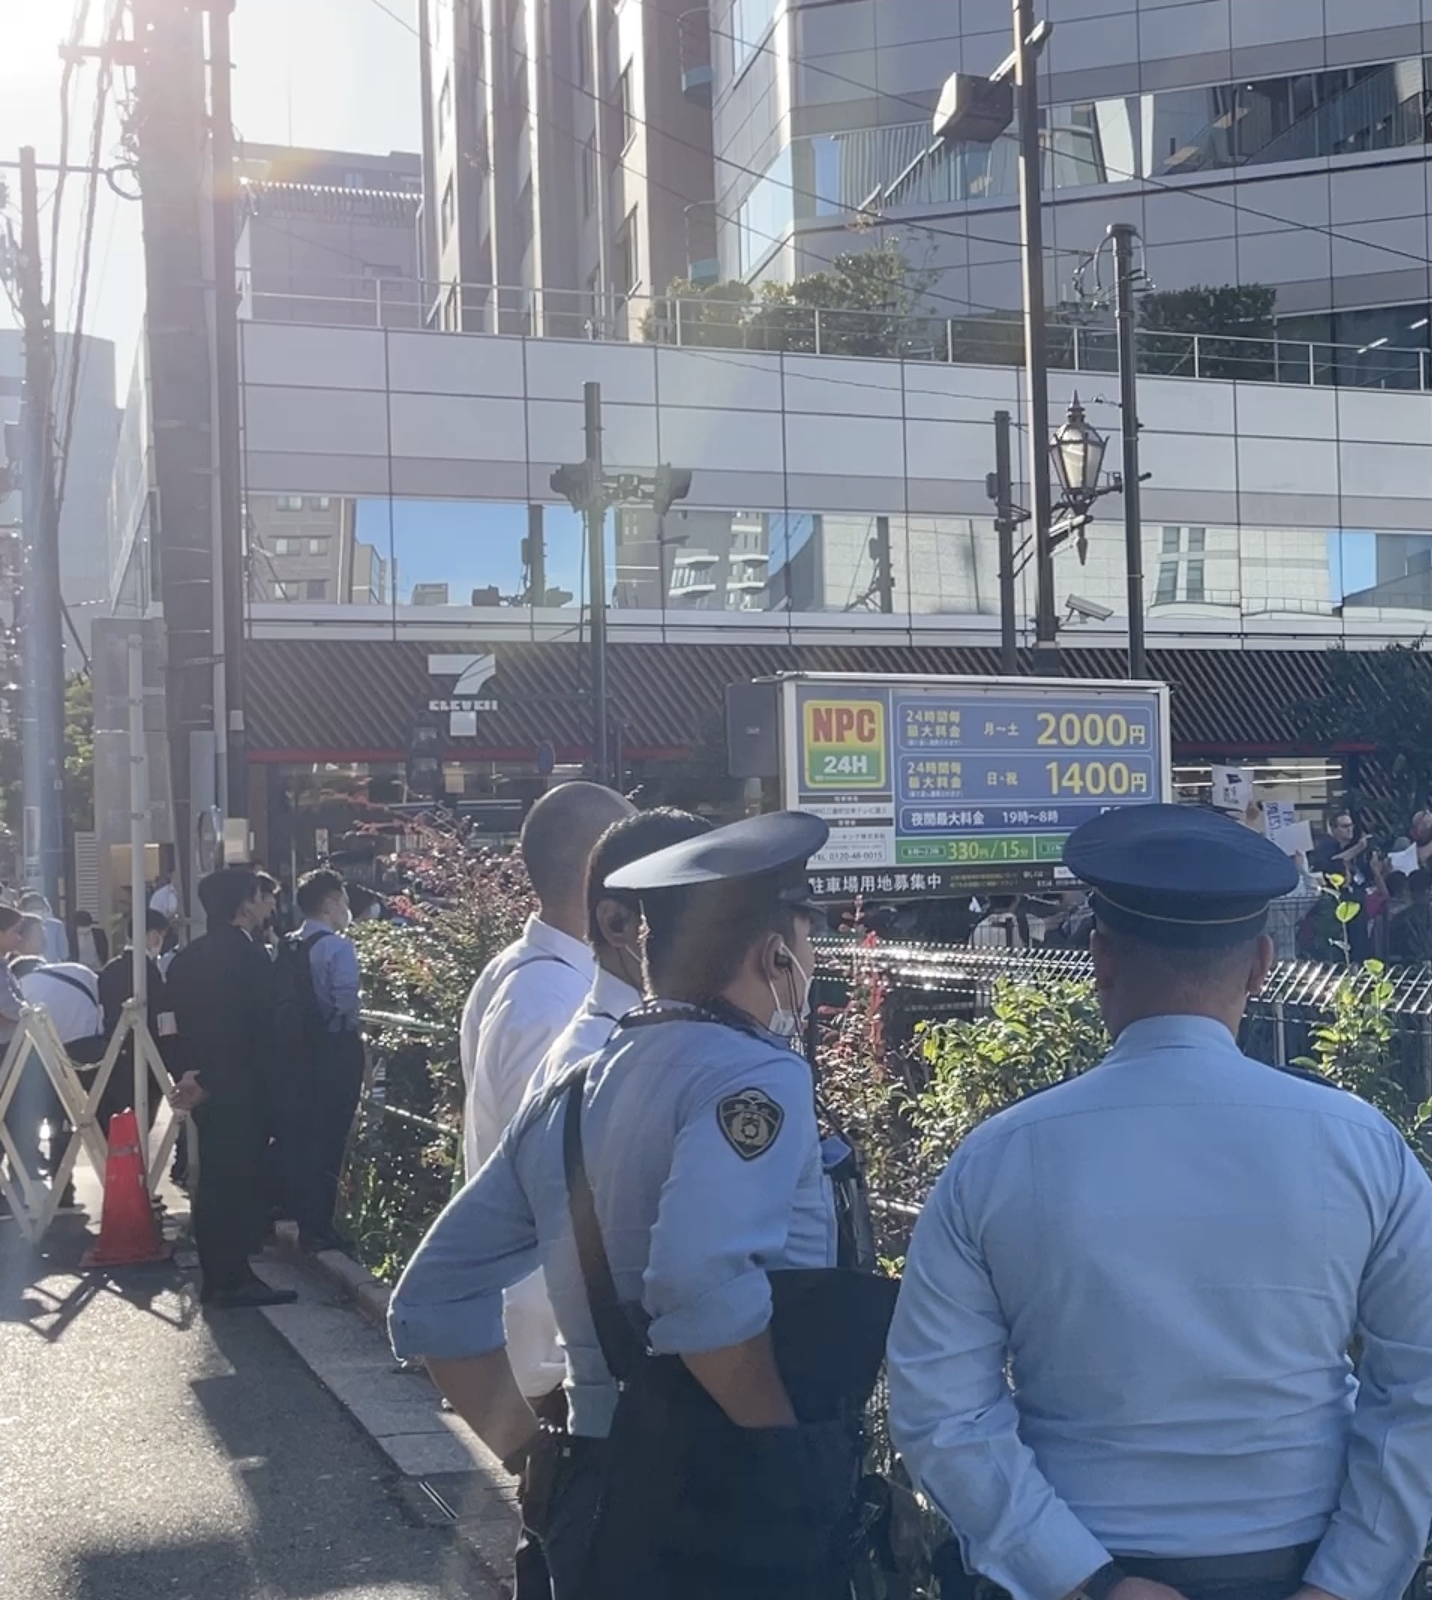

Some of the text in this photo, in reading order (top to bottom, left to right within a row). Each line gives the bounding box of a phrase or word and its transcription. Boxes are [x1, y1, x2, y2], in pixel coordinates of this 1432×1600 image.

[812, 707, 876, 743] NPC
[1037, 713, 1146, 746] 2000円
[823, 755, 868, 774] 24H
[1045, 761, 1147, 795] 1400円
[911, 811, 985, 827] 夜間最大料金
